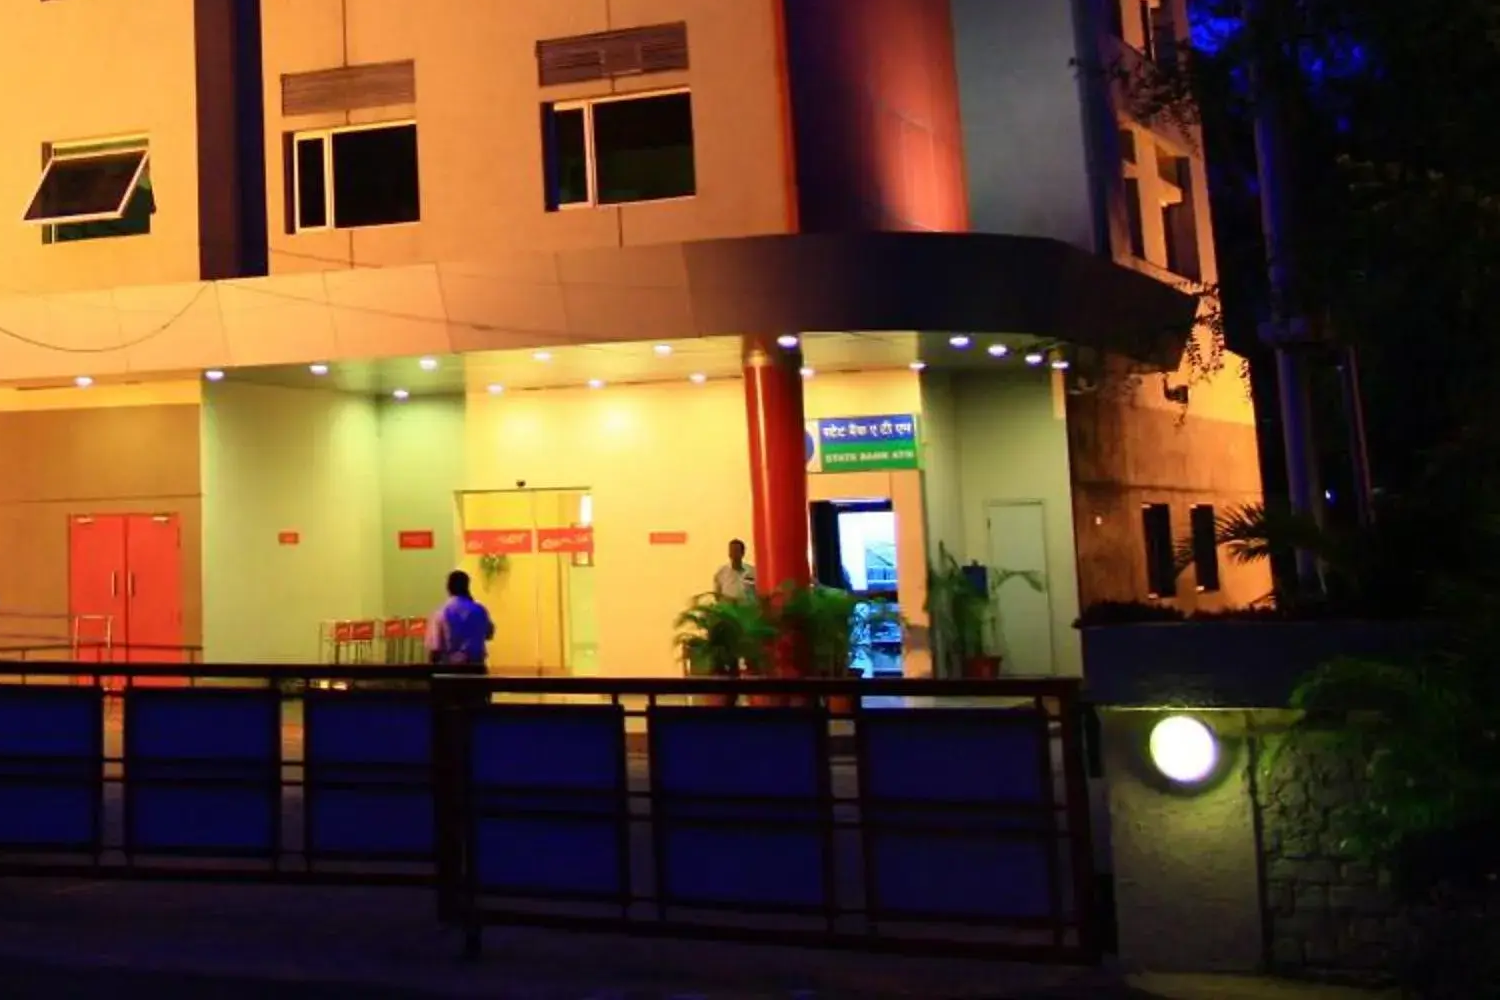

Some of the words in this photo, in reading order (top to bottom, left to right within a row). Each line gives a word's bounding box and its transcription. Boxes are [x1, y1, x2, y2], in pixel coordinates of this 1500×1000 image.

[825, 452, 857, 463] STATE
[859, 451, 889, 462] BANK
[892, 449, 914, 460] ATM
